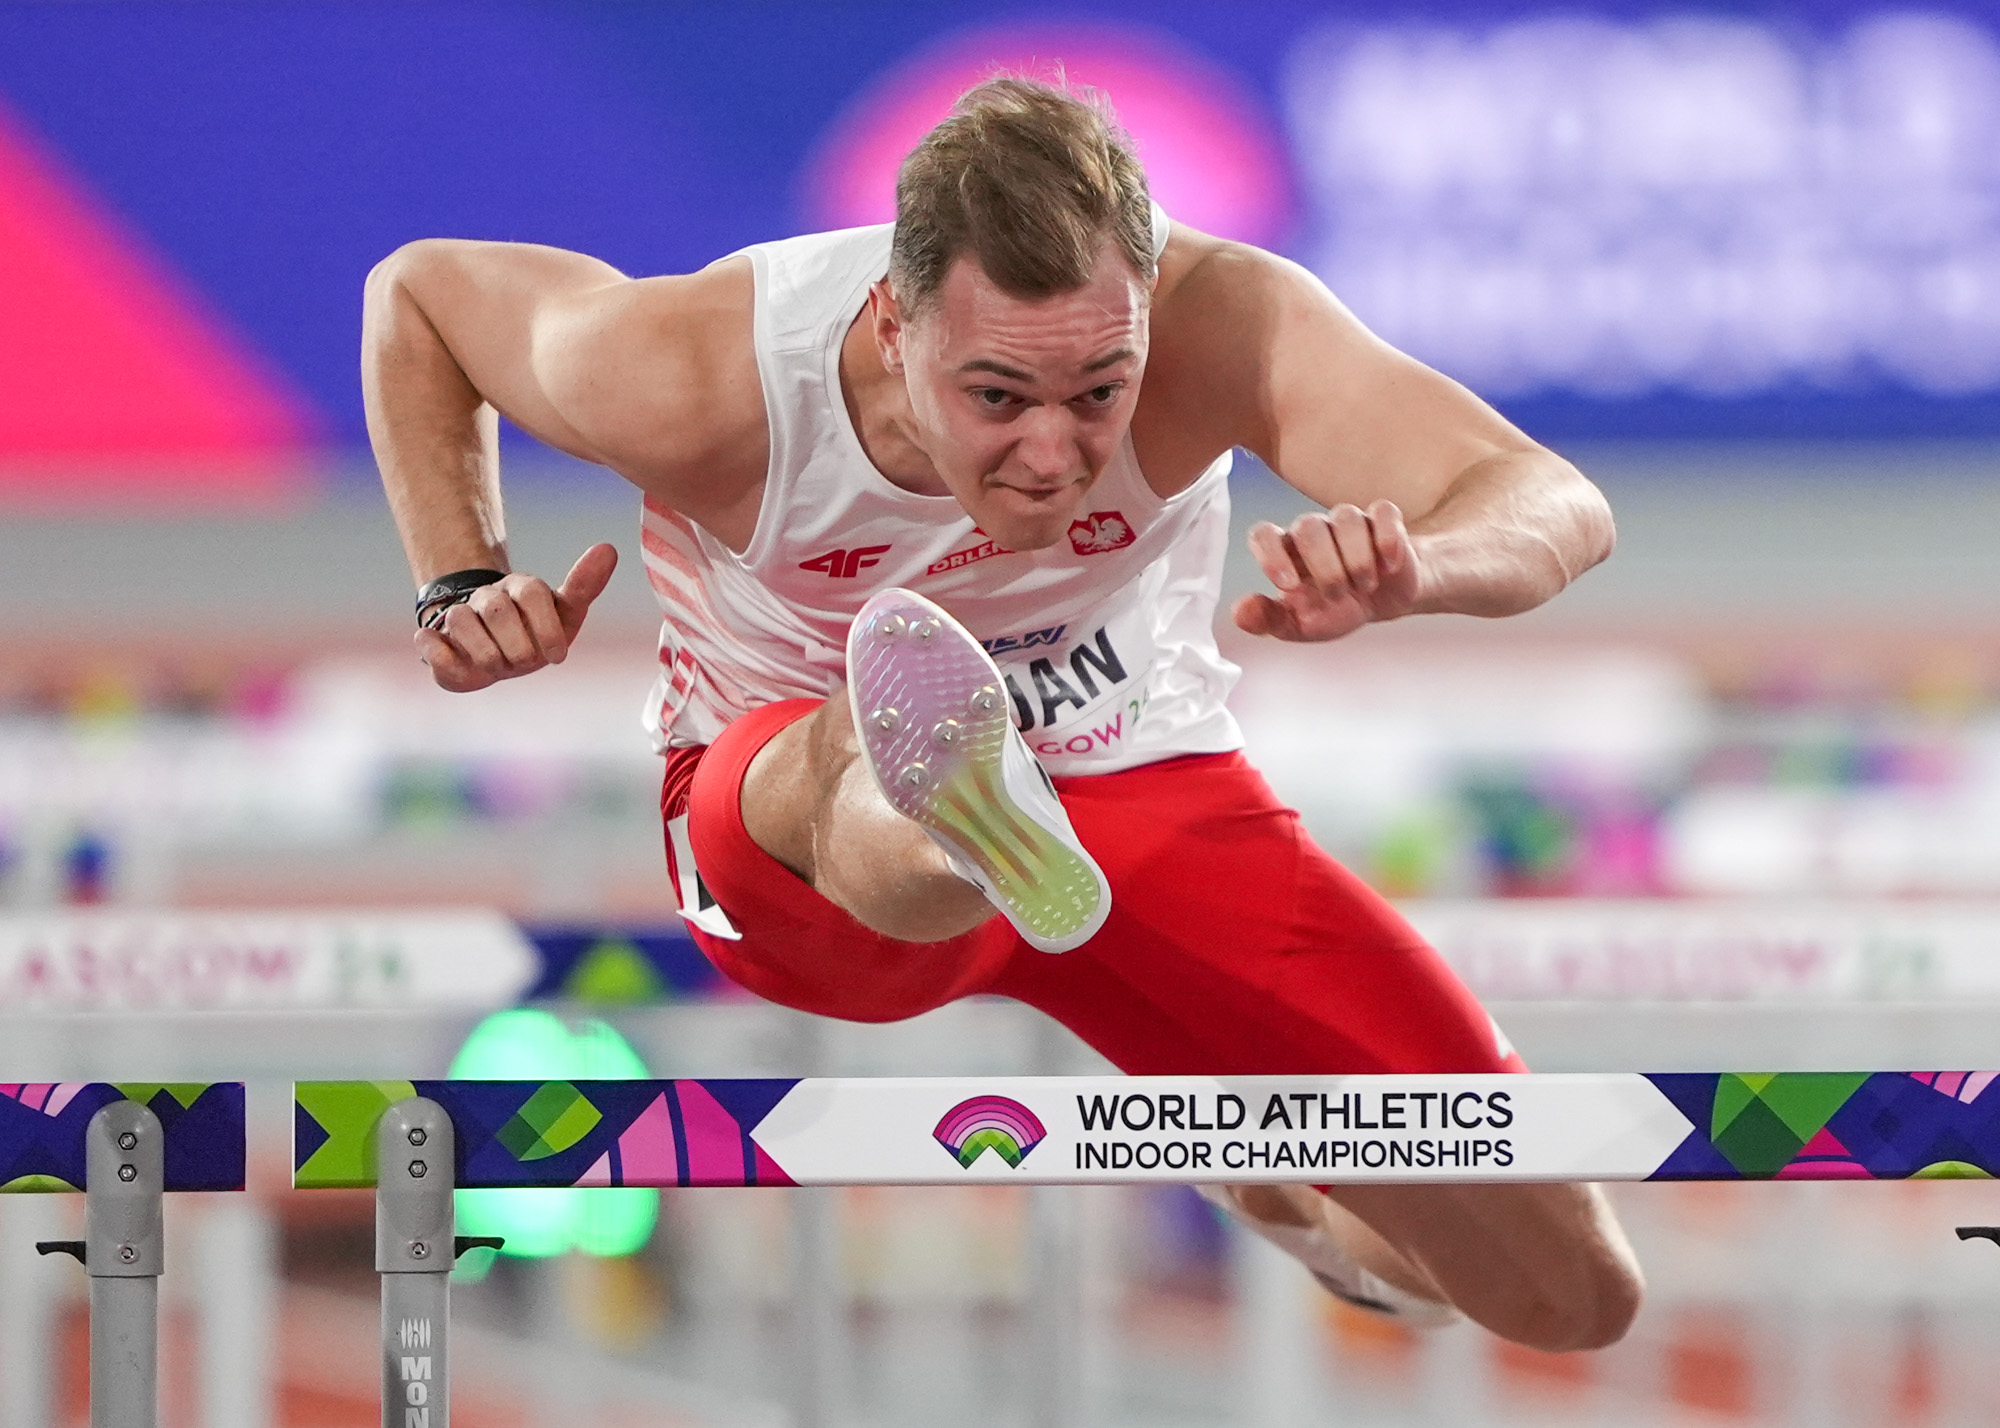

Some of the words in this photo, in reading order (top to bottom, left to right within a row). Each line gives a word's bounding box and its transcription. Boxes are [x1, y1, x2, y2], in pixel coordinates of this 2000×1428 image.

[798, 543, 893, 578] 4F
[1076, 1094, 1246, 1131] WORLD
[1260, 1092, 1514, 1130] ATHLETICS
[1076, 1141, 1212, 1169] INDOOR
[1222, 1139, 1514, 1168] CHAMPIONSHIPS
[401, 1356, 431, 1428] MON
